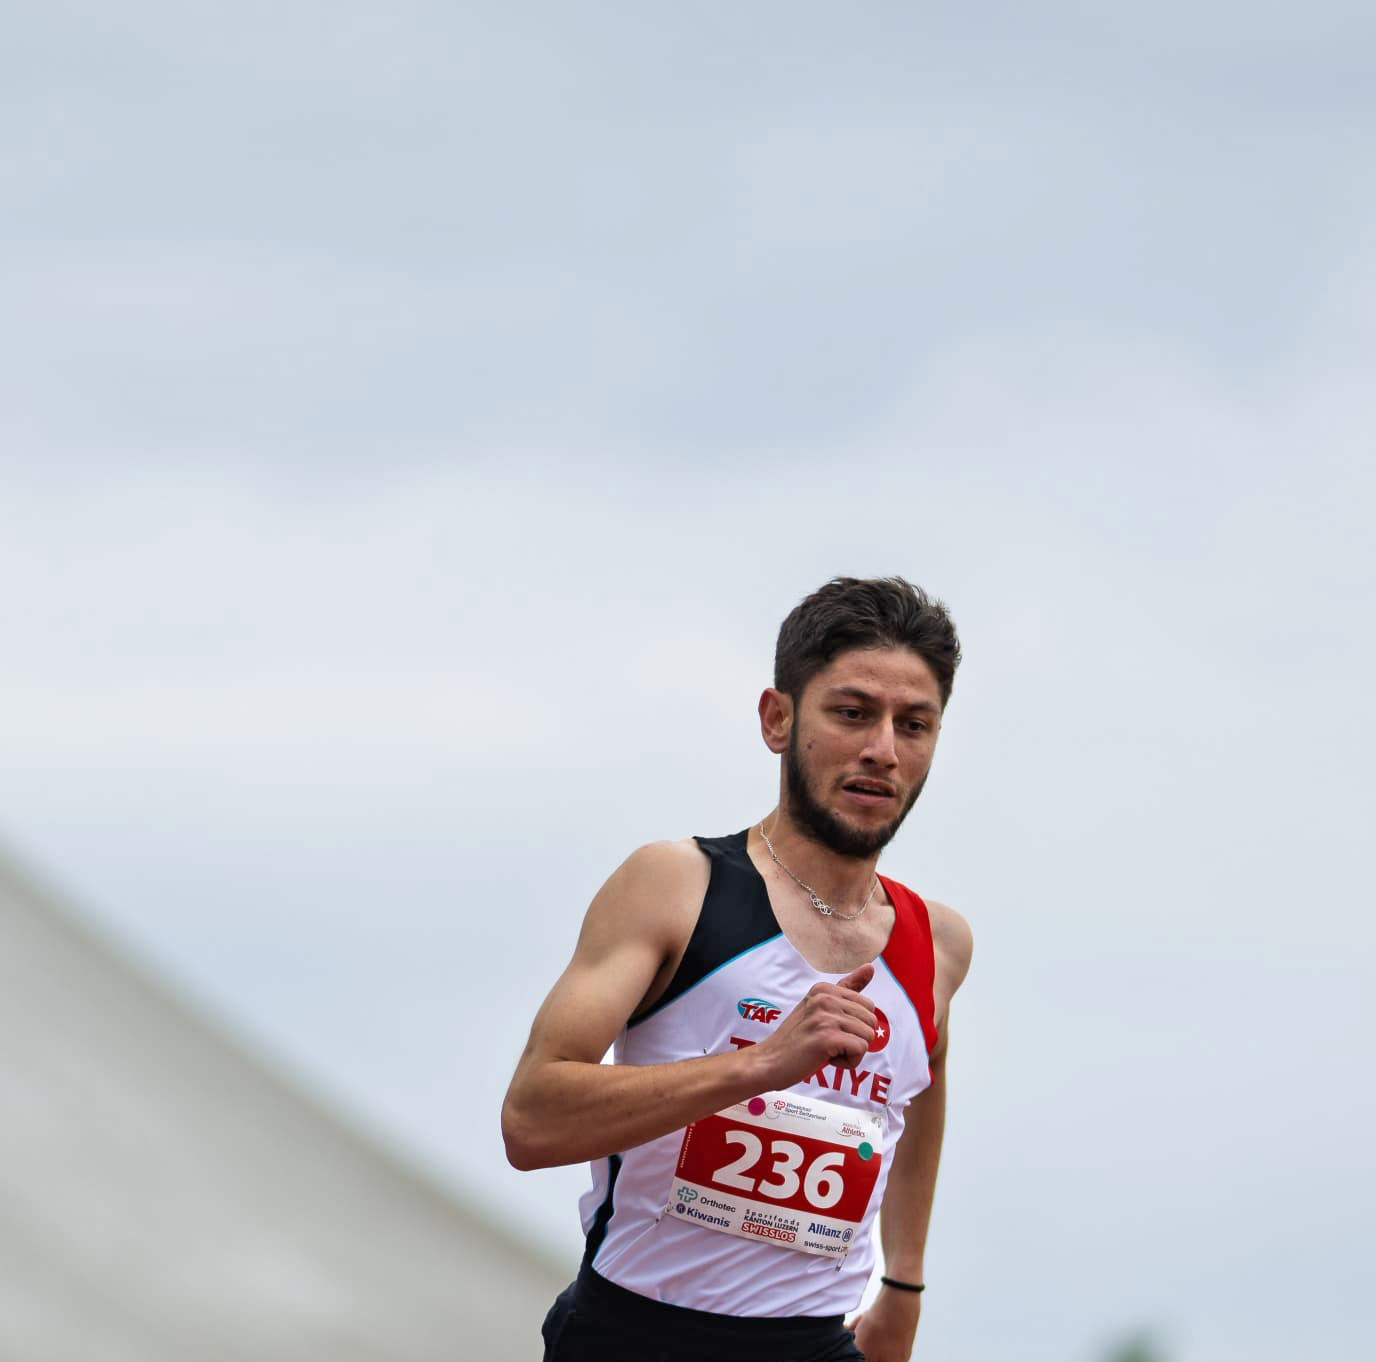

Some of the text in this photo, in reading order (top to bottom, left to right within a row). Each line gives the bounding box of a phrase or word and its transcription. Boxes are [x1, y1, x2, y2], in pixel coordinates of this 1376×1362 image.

[740, 1002, 782, 1024] TAF
[711, 1130, 846, 1209] 236
[700, 1196, 736, 1213] Orthotec
[687, 1207, 731, 1228] Kiwanis
[744, 1215, 799, 1233] KANTON LUZERN
[742, 1222, 796, 1243] SWISSLOS
[807, 1222, 842, 1239] Allianz
